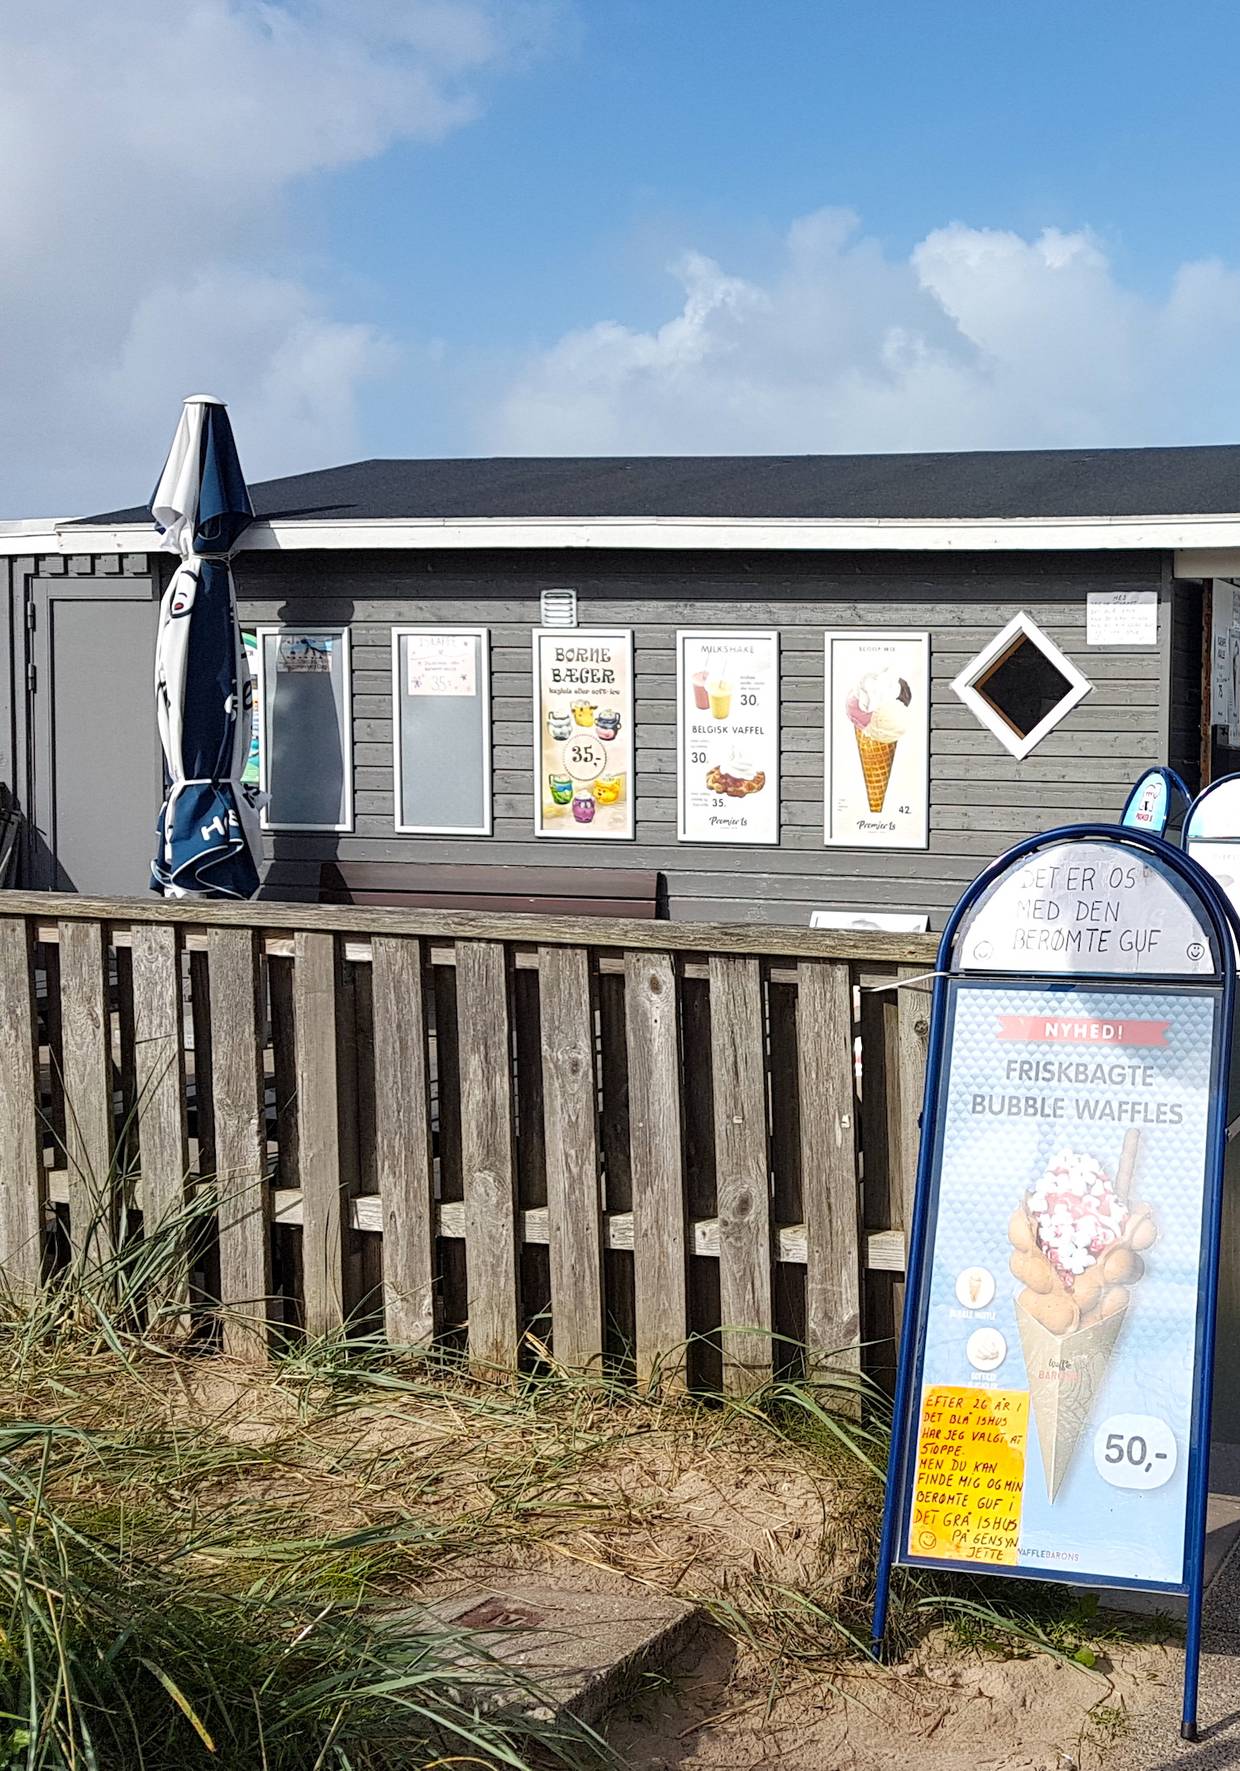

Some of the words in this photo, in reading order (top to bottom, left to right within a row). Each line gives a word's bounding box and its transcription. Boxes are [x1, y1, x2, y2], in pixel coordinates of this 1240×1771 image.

[551, 667, 616, 684] BÆGER
[691, 725, 729, 734] BELGISK
[731, 726, 765, 735] VAFFEL
[571, 745, 602, 768] 35,-
[1020, 867, 1056, 889] DET
[1067, 867, 1096, 891] ER
[1109, 867, 1137, 888] OS
[1016, 900, 1060, 922] MED
[1075, 900, 1121, 922] DEN
[1012, 928, 1113, 953] BERØMTE
[1119, 929, 1162, 953] GUF
[1044, 1020, 1124, 1041] NYHED!
[1005, 1060, 1155, 1087] FRISKBAGTE
[970, 1093, 1065, 1120] BUBBLE
[1075, 1097, 1184, 1125] WAFFLES
[926, 1395, 964, 1409] EFTER
[973, 1398, 988, 1409] 26
[994, 1397, 1011, 1411] ÅR
[923, 1411, 943, 1423] DET
[949, 1411, 973, 1425] BLÅ
[975, 1416, 1008, 1427] ISHUS
[921, 1427, 942, 1440] HAR
[943, 1429, 965, 1441] JEG
[971, 1431, 1006, 1443] VALGT
[1009, 1435, 1024, 1445] AT
[1104, 1433, 1168, 1473] 50,-
[919, 1458, 944, 1470] MEN
[951, 1458, 967, 1472] DU
[973, 1461, 998, 1474] KAN
[917, 1472, 954, 1487] FINDE
[958, 1475, 981, 1489] MIG
[986, 1478, 1002, 1490] OG
[1004, 1478, 1024, 1492] MIN
[916, 1490, 969, 1507] BERØMTE
[977, 1496, 1004, 1510] GUF
[912, 1508, 940, 1525] DET
[943, 1511, 972, 1527] GRÅ
[977, 1515, 1018, 1532] ISHUS
[951, 1529, 970, 1543] PÅ
[972, 1532, 1019, 1549] GENSYN
[966, 1546, 1005, 1561] JETTE
